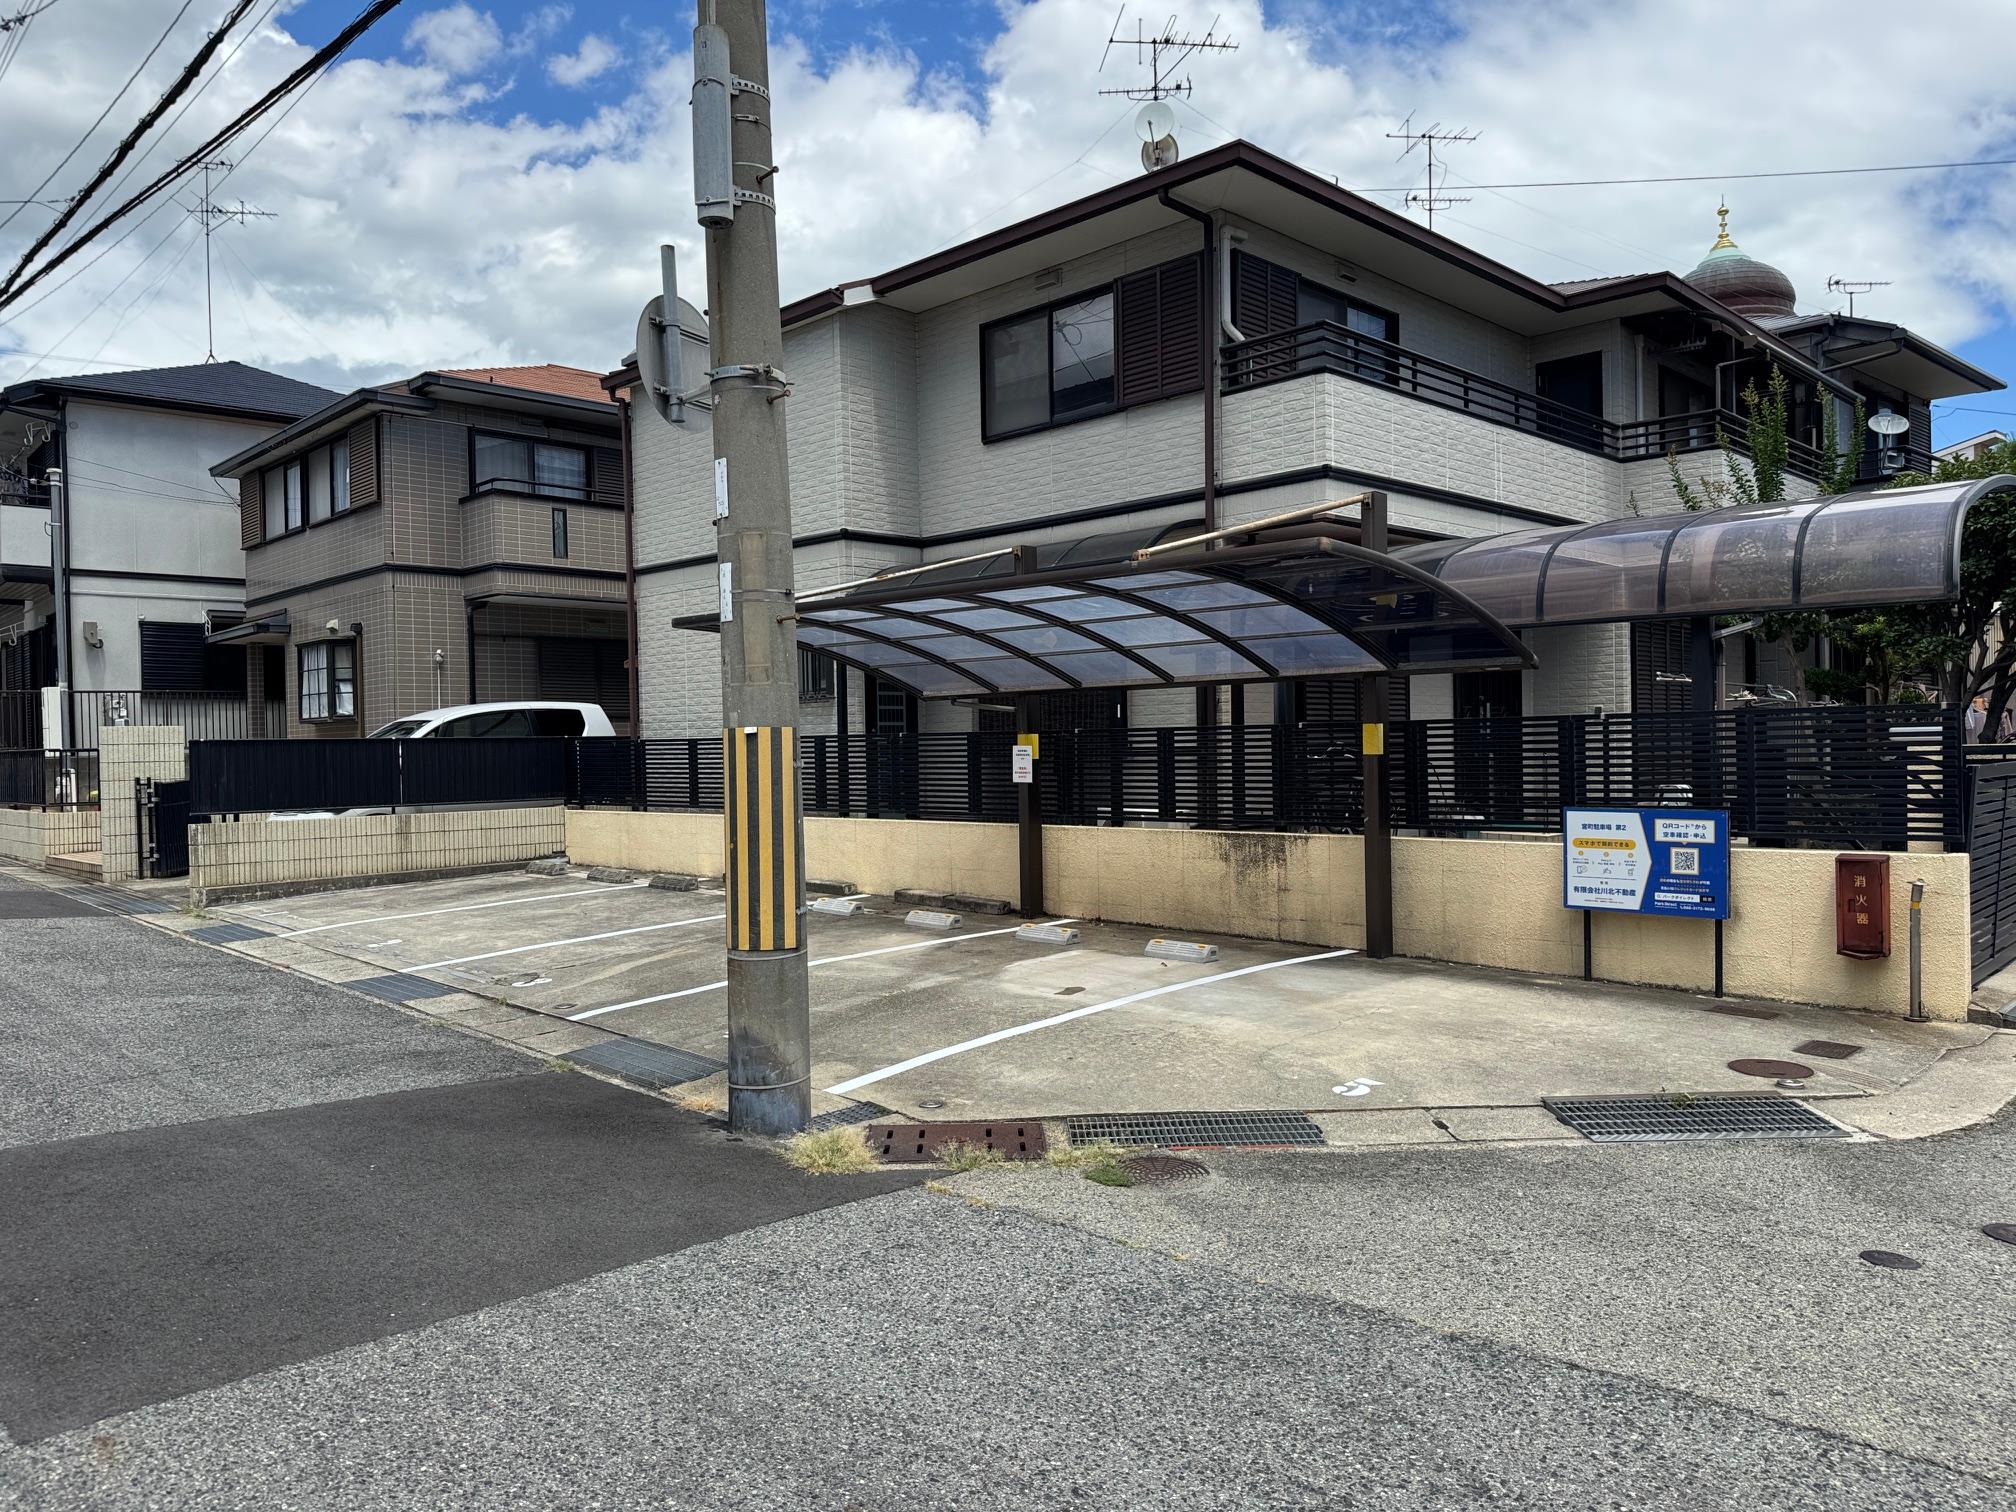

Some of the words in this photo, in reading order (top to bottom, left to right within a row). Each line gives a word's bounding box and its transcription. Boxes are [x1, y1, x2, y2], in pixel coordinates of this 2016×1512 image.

[1573, 885, 1637, 897] 有限会社川北不動産
[1854, 874, 1869, 925] 消火器
[1331, 1077, 1387, 1097] 5
